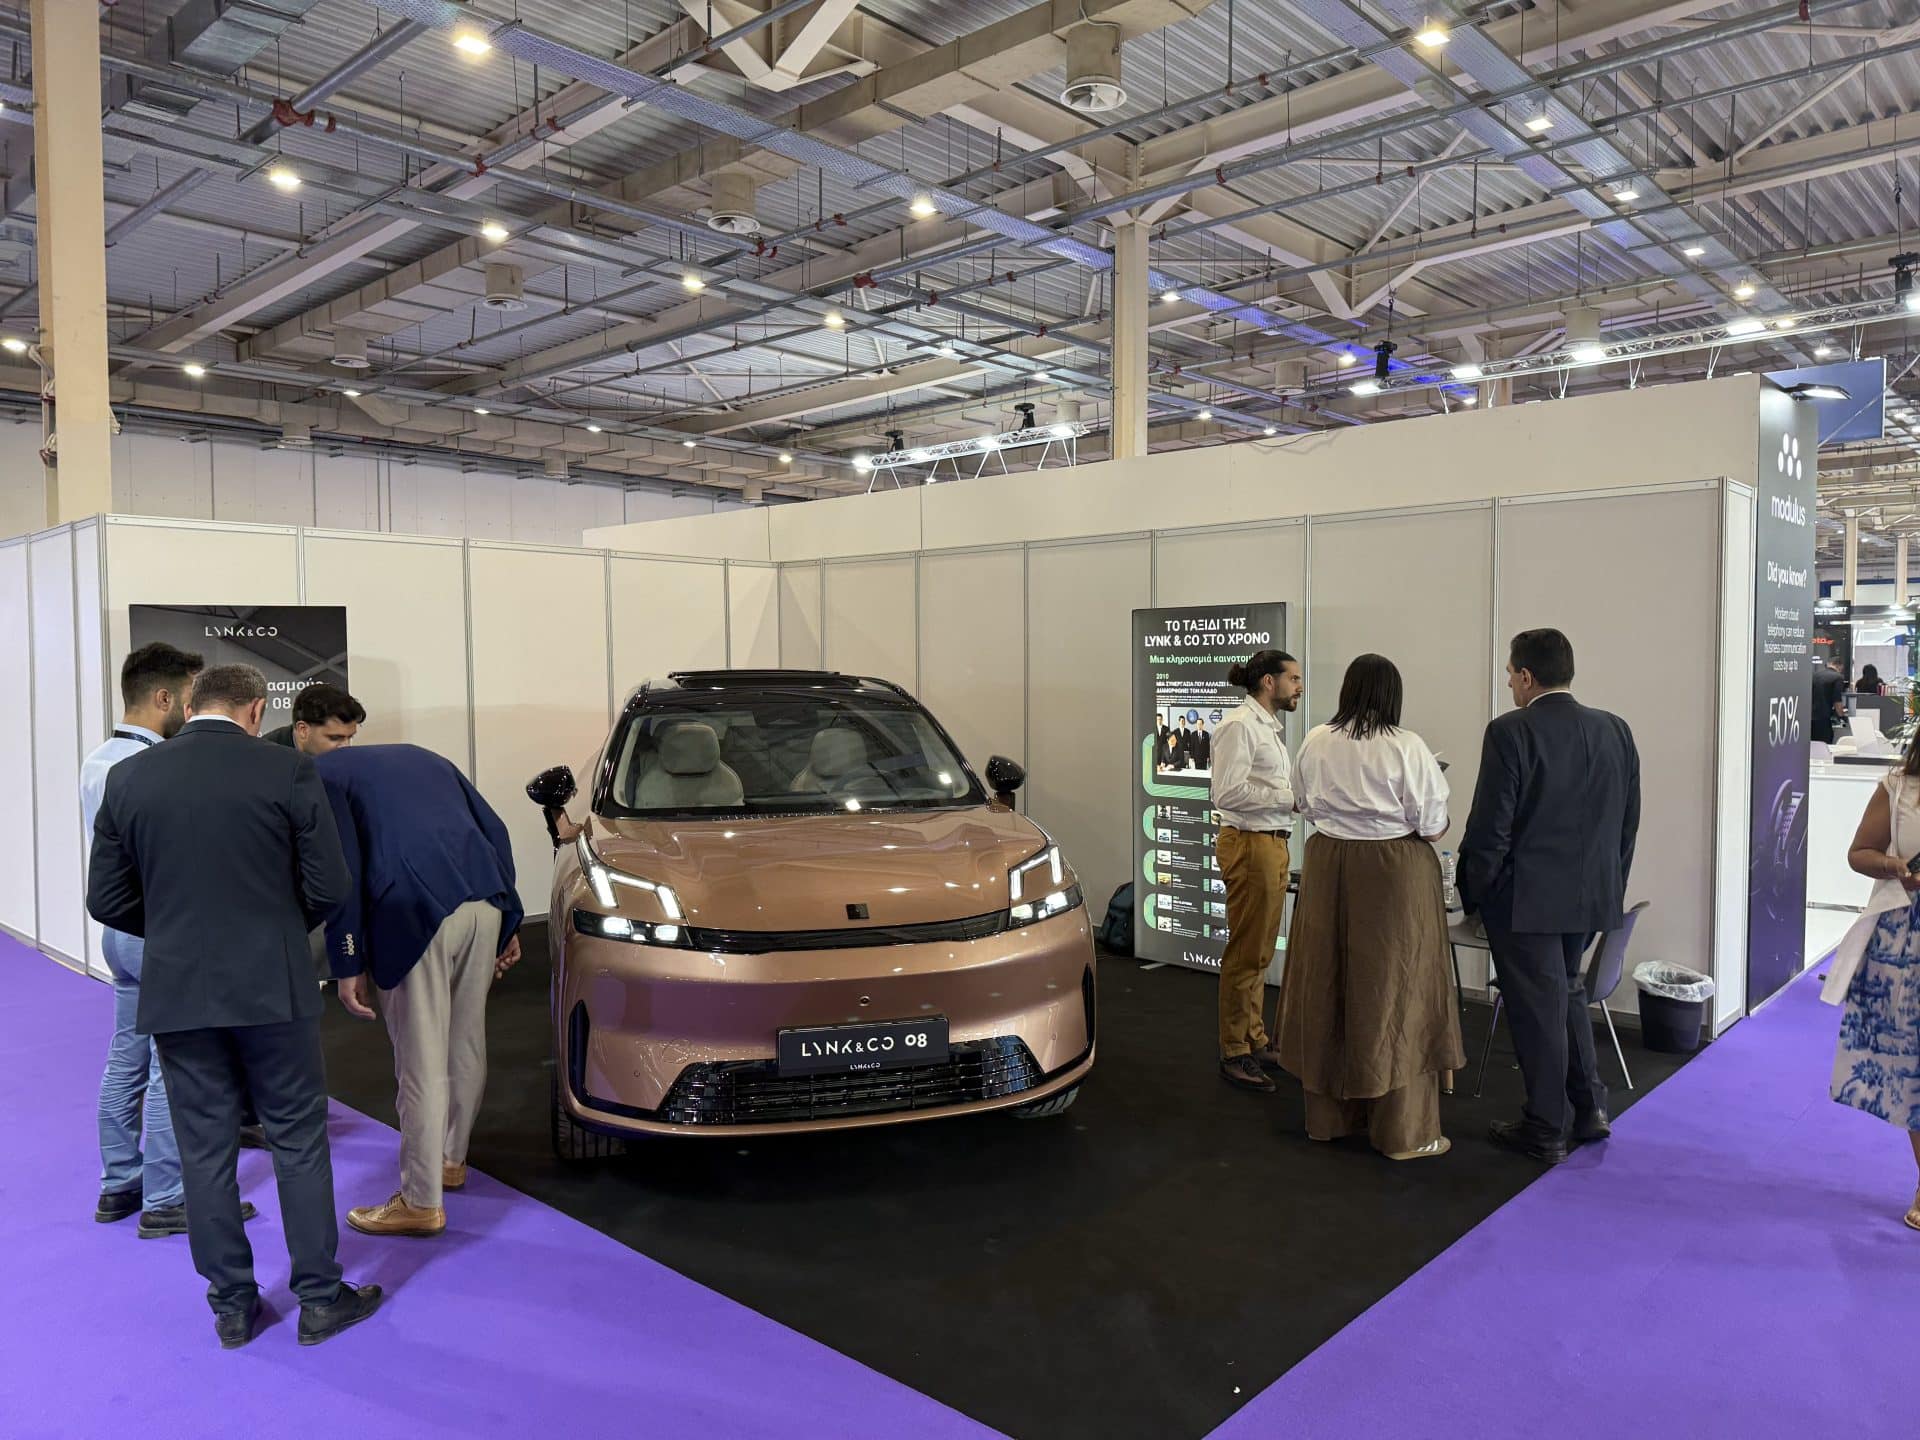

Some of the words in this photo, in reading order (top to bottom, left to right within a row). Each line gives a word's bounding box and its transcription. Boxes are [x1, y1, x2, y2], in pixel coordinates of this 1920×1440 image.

[1771, 494, 1805, 526] modulus
[1767, 560, 1777, 582] Did
[1777, 567, 1788, 589] you
[1789, 564, 1807, 588] know?
[205, 626, 278, 637] LYNK&CO
[1165, 620, 1180, 631] ΤΟ
[1183, 619, 1220, 630] ΤΑΞΙΔΙ
[1222, 617, 1247, 630] ΤΗΣ
[1144, 635, 1171, 647] LYNK
[1174, 635, 1181, 646] &
[1184, 634, 1200, 646] CO
[1202, 634, 1225, 646] ΣΤΟ
[1228, 632, 1270, 645] ΧΡΟΝΟ
[1149, 655, 1164, 664] Μια
[1166, 653, 1212, 665] κληρονομιά
[272, 697, 292, 710] 08
[1768, 696, 1800, 747] 50%
[1183, 951, 1223, 968] LYNK&C
[802, 1036, 894, 1057] LYNK&CO
[904, 1033, 928, 1048] 08
